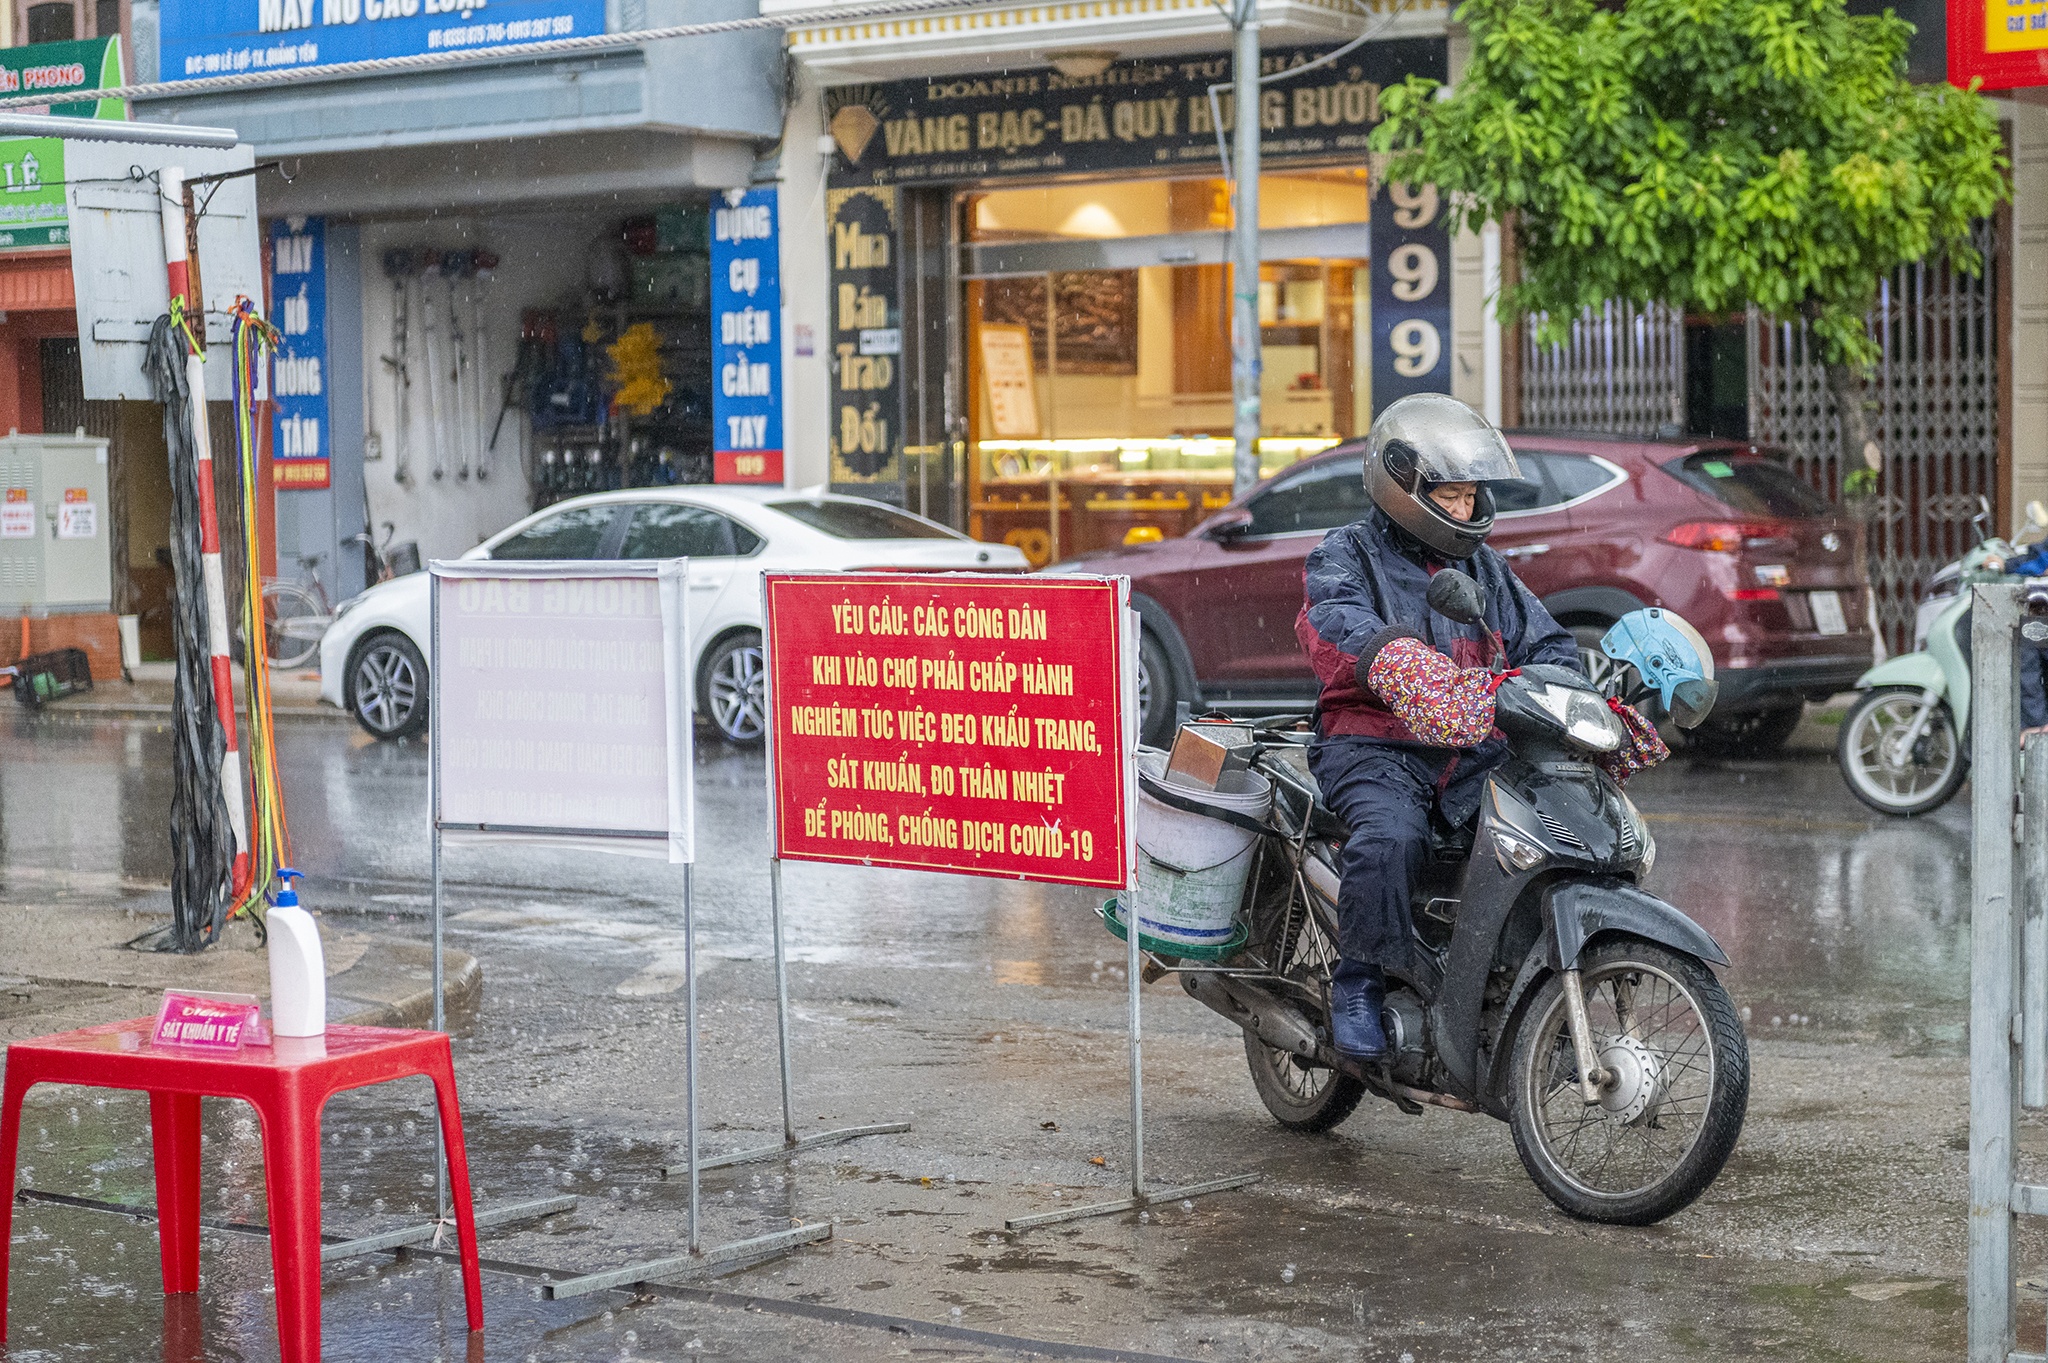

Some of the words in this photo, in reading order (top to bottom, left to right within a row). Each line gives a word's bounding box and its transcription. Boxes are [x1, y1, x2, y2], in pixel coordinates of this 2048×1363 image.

[23, 63, 85, 90] PHONG
[883, 110, 970, 157] VÀNG
[1112, 89, 1179, 142] QUÝ
[3, 151, 41, 193] LÊ
[715, 205, 771, 246] DỤNG
[835, 221, 890, 270] Mua
[729, 257, 760, 297] CỤ
[721, 306, 771, 349] ĐIỆN
[838, 283, 888, 331] Bán
[721, 351, 770, 398] CẦM
[836, 342, 893, 391] Trao
[727, 415, 768, 450] TAY
[840, 401, 888, 454] Đổi
[832, 598, 864, 635] YÊU
[869, 594, 909, 636] CẦU:
[913, 600, 949, 637] CÁC
[954, 601, 1004, 639] CÔNG
[1008, 603, 1047, 641] DÂN
[812, 655, 841, 686] KHI
[845, 650, 878, 688] VÀO
[883, 655, 918, 695] CHỢ
[922, 650, 965, 691] PHẢI
[970, 651, 1017, 694] CHẤP
[1022, 657, 1074, 696] HÀNH
[791, 701, 857, 738] NGHIÊM
[862, 702, 894, 740] TÚC
[898, 705, 937, 748] VIỆC
[941, 712, 977, 745] ĐEO
[981, 704, 1030, 748] KHẨU
[1035, 717, 1103, 757] TRANG,
[827, 753, 858, 789] SÁT
[863, 750, 927, 798] KHUẨN,
[931, 765, 955, 797] ĐO
[959, 762, 1007, 800] THÂN
[1012, 766, 1065, 810] NHIỆT
[804, 797, 828, 838] ĐỂ
[831, 804, 894, 847] PHÒNG,
[898, 806, 958, 850] CHỐNG
[963, 818, 1005, 858] DỊCH
[1010, 823, 1093, 862] COVID-19
[161, 1019, 182, 1039] SÁT
[216, 1025, 226, 1042] Y
[225, 1021, 243, 1043] TẾ
